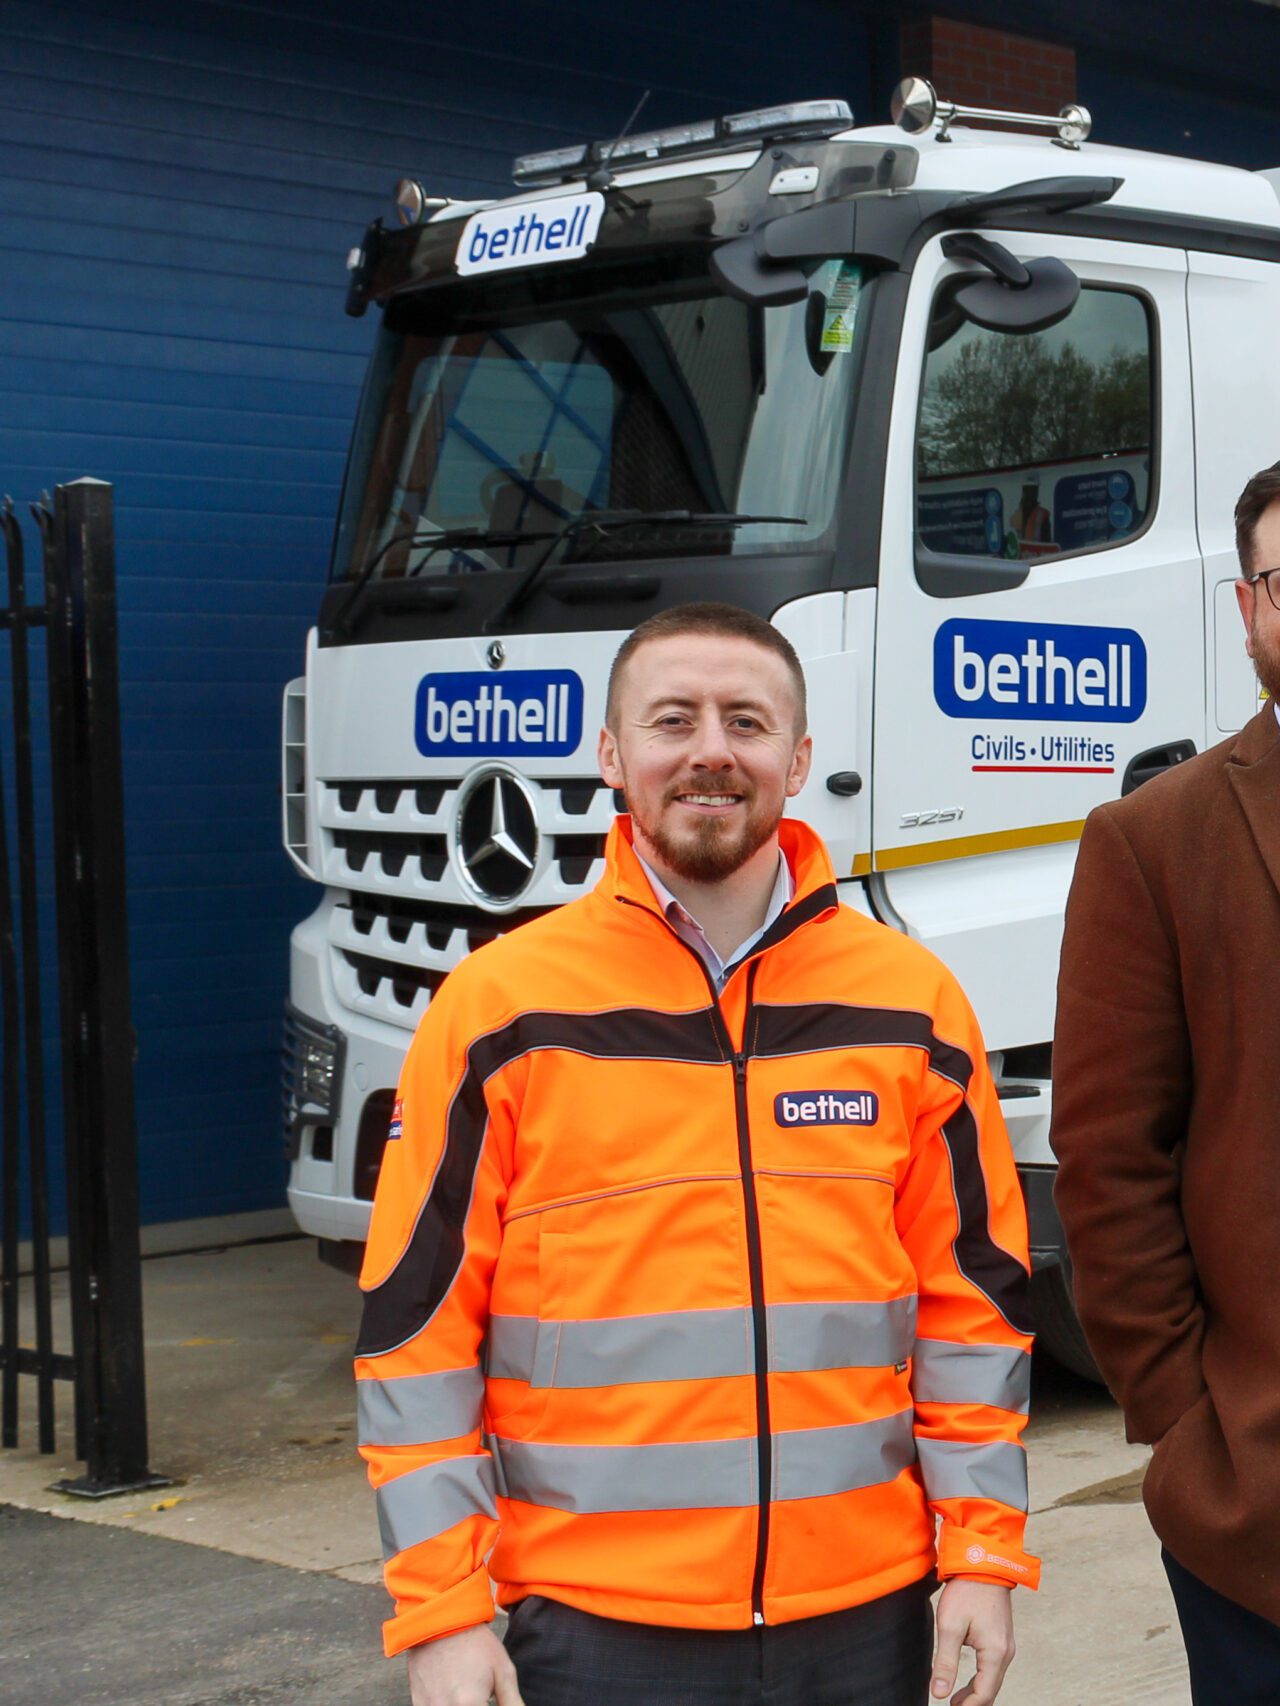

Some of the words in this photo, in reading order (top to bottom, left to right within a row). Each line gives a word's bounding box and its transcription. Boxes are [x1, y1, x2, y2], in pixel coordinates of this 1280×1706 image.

[469, 204, 591, 263] bethell
[953, 635, 1131, 707] bethell
[426, 684, 569, 743] bethell
[899, 807, 964, 829] 3251
[782, 1095, 872, 1122] bethell
